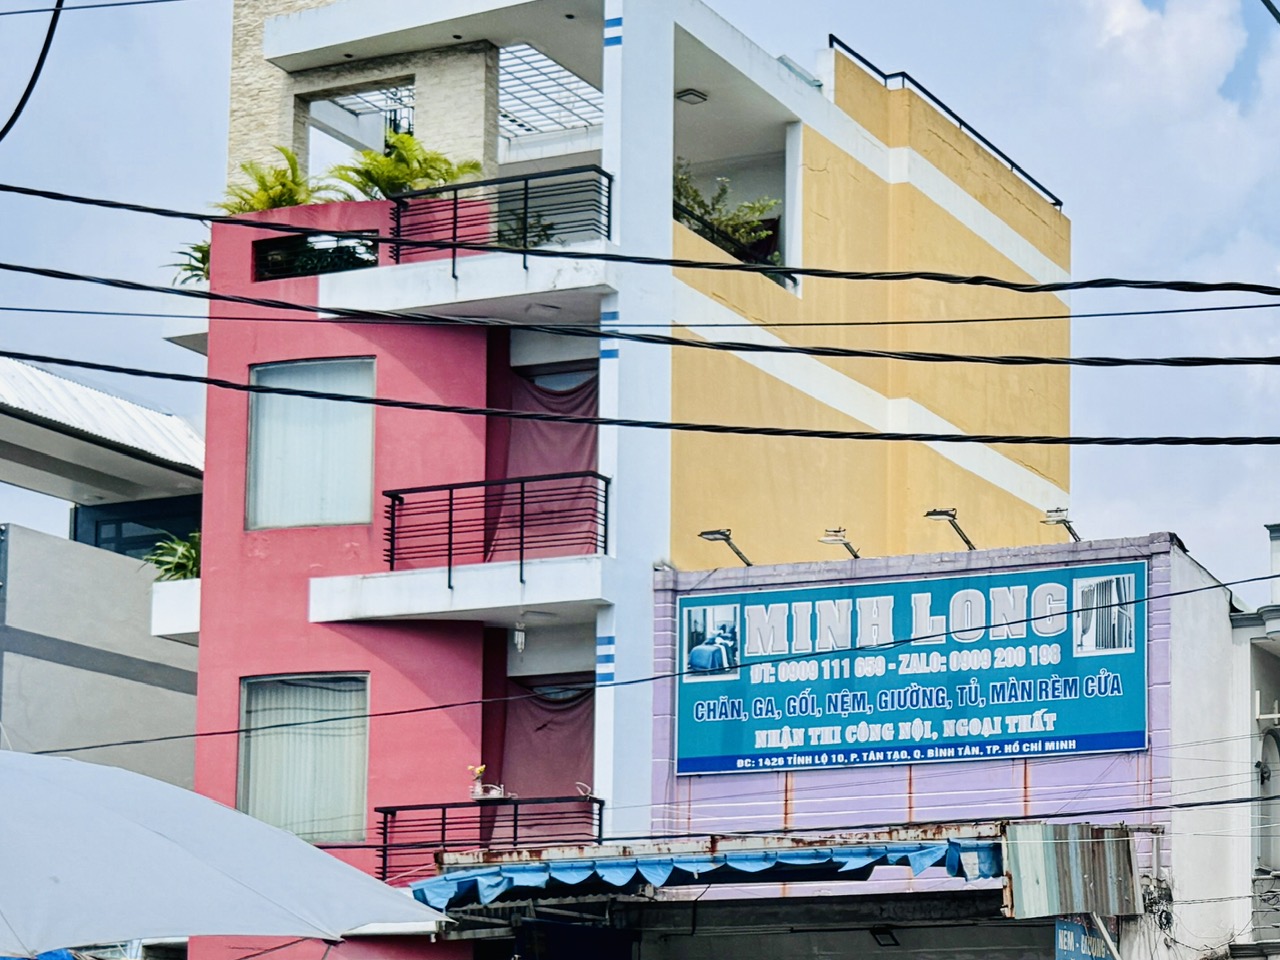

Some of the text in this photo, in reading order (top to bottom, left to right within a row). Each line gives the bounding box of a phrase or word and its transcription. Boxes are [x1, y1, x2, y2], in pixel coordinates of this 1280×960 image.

[744, 582, 1068, 657] MINH LONG
[750, 663, 775, 684] ĐT:
[778, 660, 819, 682] 0909
[821, 658, 850, 680] 111
[854, 656, 886, 677] 659
[898, 652, 947, 675] ZALO:
[949, 649, 992, 671] 0909
[994, 646, 1026, 668] 200
[1029, 643, 1061, 666] 198
[694, 668, 1123, 721] CHĂN, GA, GỐI, NỆM, GIƯỜNG, TỦ, MÀN RÈM CỬA
[754, 708, 1057, 750] NHẬN THI CÔNG NỘI, NGOẠI THẤT
[862, 750, 884, 761] TÂN
[927, 746, 955, 758] BÌNH
[1044, 739, 1077, 751] MINH
